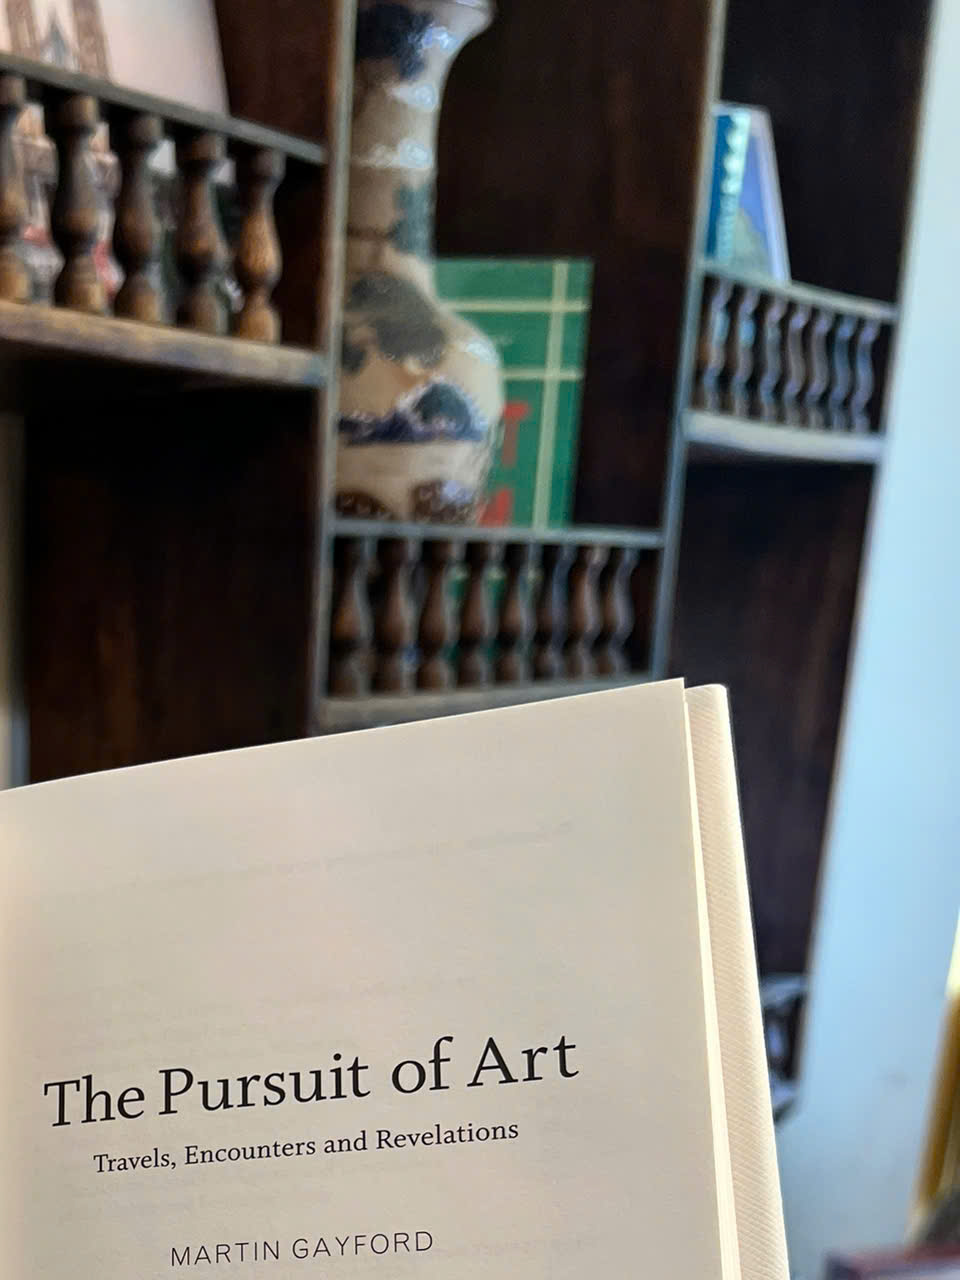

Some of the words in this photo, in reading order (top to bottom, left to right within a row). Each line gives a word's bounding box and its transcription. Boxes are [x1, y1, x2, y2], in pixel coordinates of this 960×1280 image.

[44, 1074, 144, 1126] The
[159, 1053, 370, 1115] Pursuit
[392, 1036, 453, 1093] of
[467, 1036, 579, 1087] Art
[94, 1148, 176, 1172] Travels,
[185, 1140, 315, 1164] Encounters
[324, 1130, 367, 1153] and
[376, 1123, 518, 1149] Revelations
[171, 1240, 279, 1267] MARTIN
[292, 1231, 433, 1259] GAYFORD
